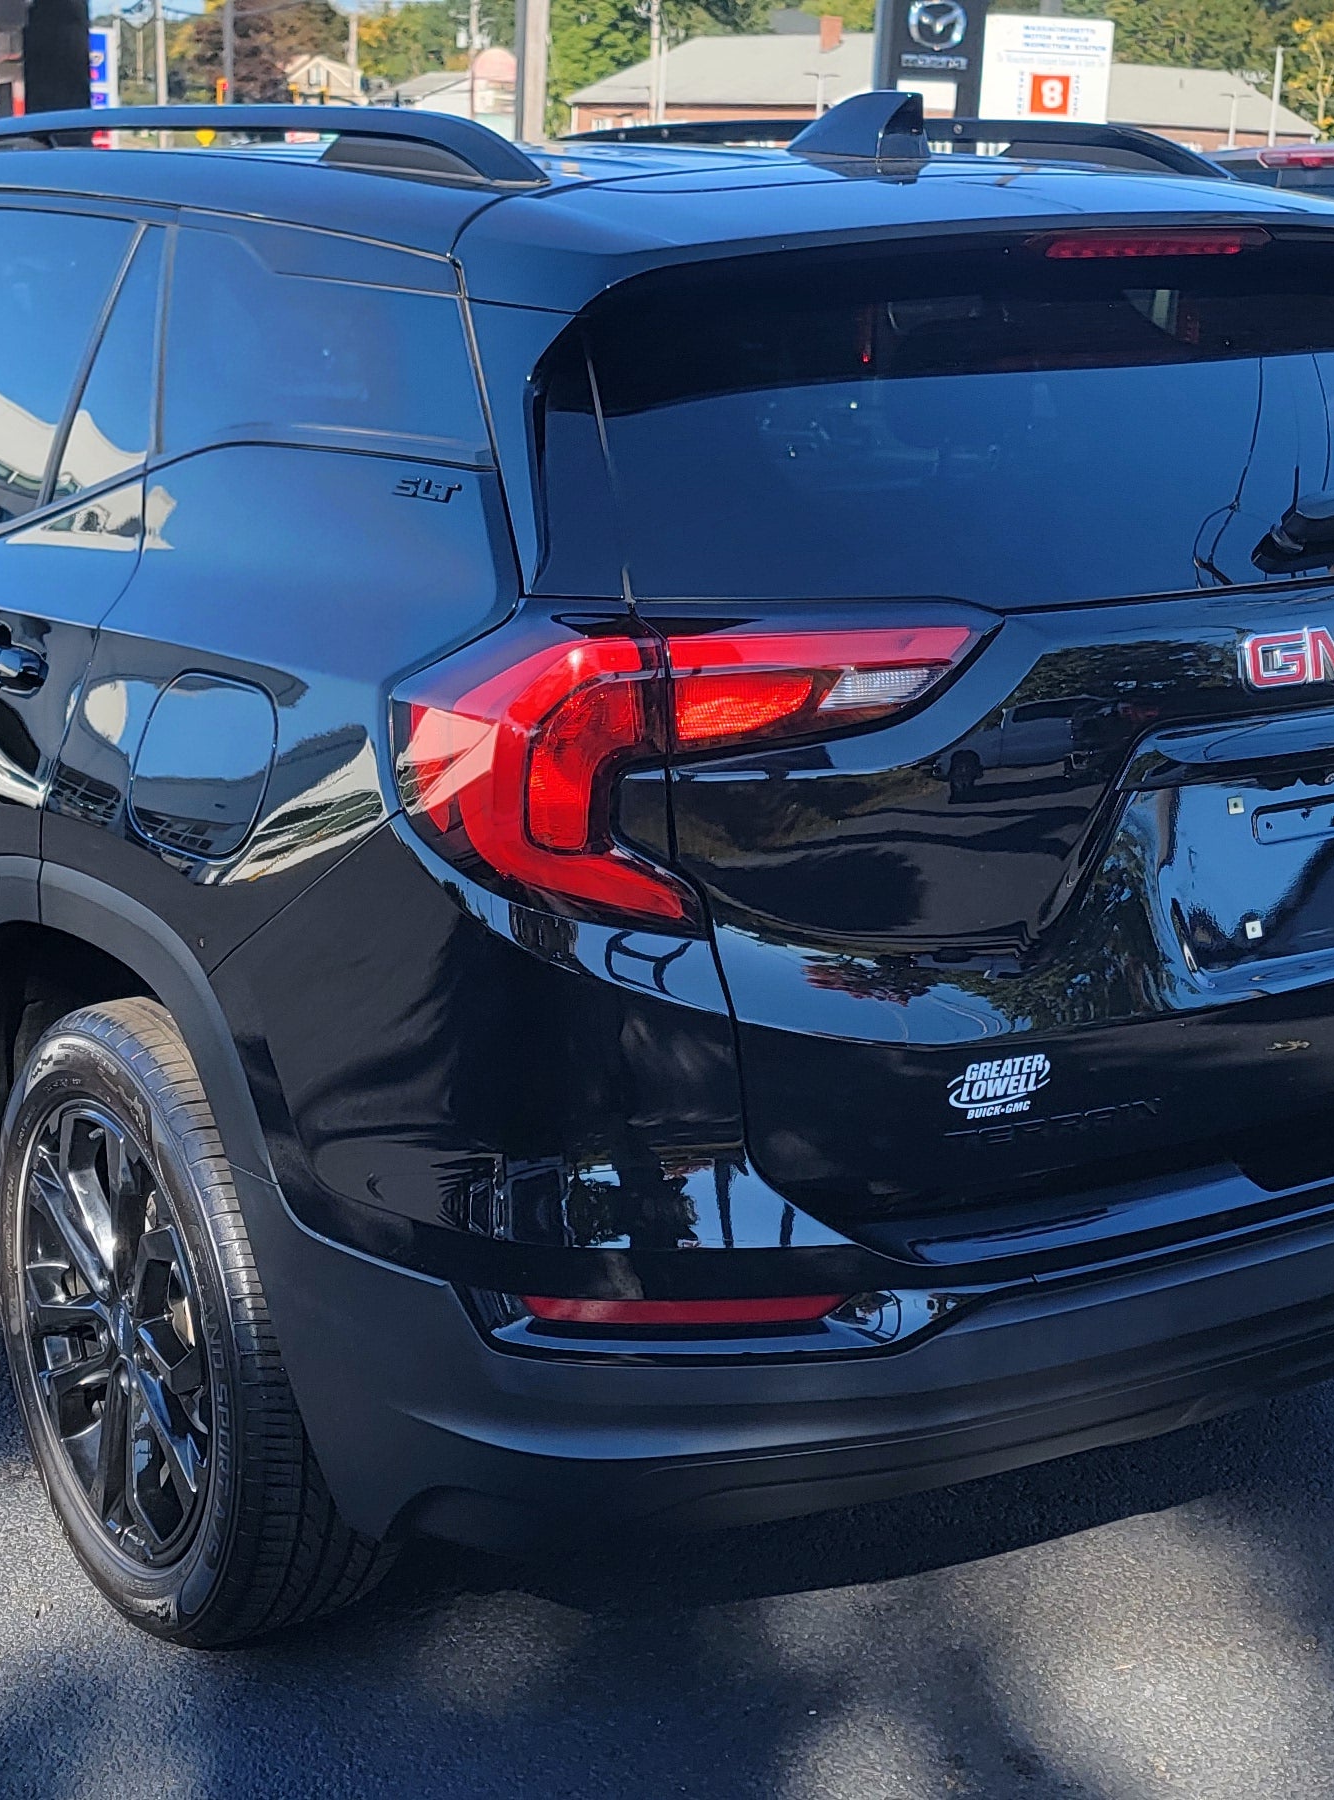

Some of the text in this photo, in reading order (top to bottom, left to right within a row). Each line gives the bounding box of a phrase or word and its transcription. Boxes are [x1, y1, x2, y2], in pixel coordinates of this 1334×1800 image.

[1042, 79, 1063, 109] 8
[391, 476, 463, 504] SLT
[964, 1053, 1046, 1082] GREATER
[960, 1072, 1039, 1102] LOWELL
[944, 1097, 1162, 1147] TERRAIN
